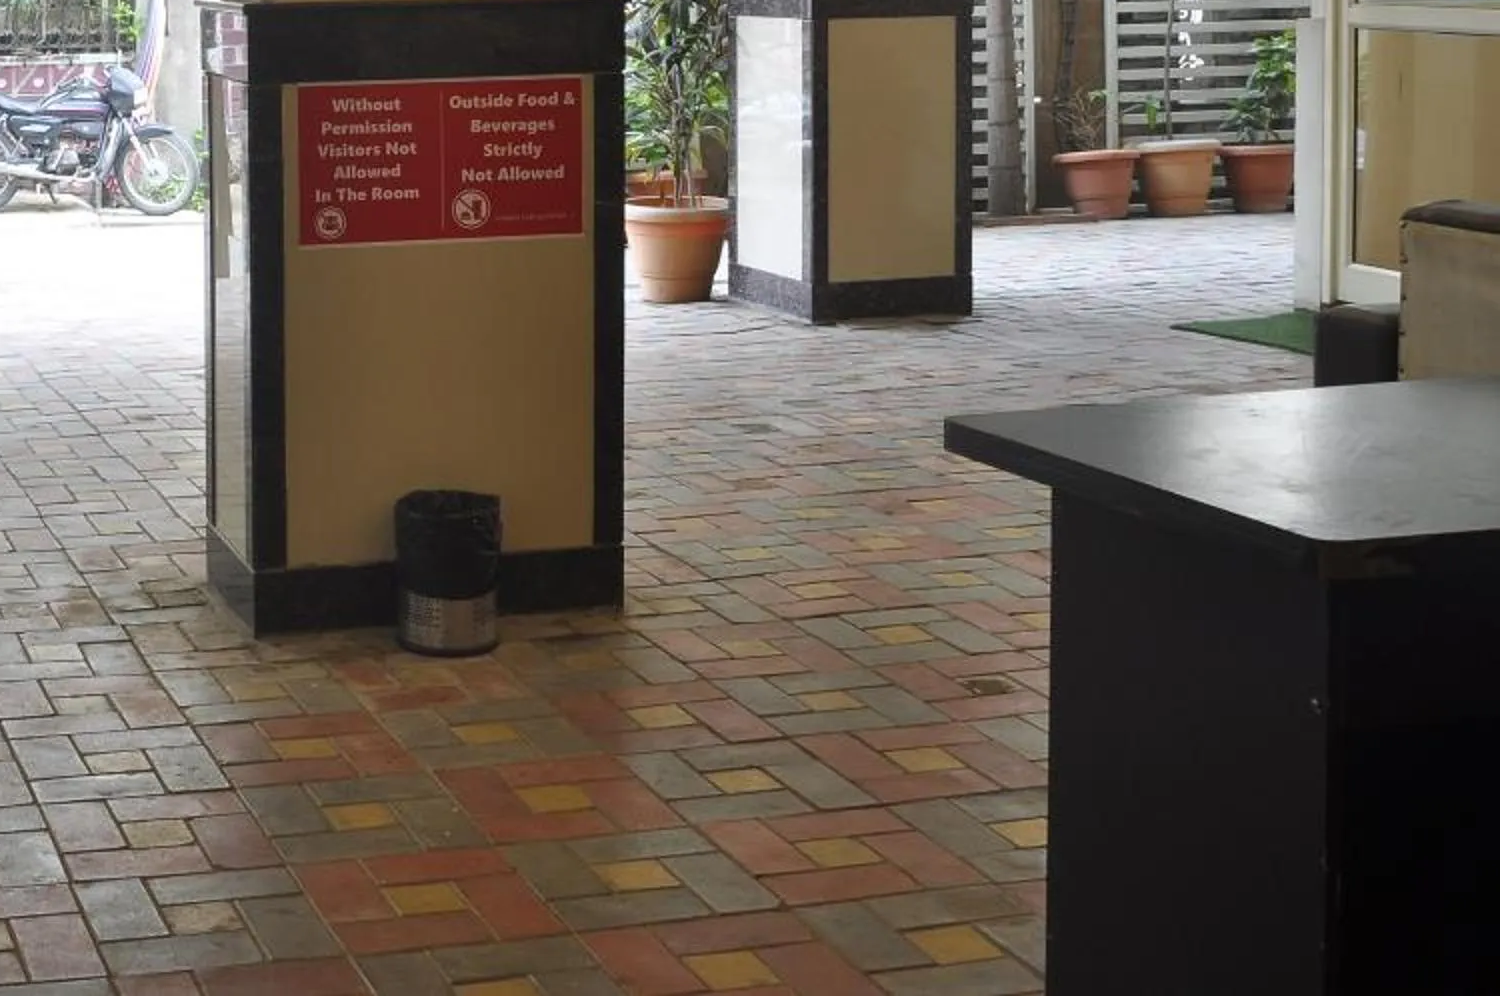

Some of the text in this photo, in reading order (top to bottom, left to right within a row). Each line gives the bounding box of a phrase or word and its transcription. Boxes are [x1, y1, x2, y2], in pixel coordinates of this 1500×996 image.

[331, 97, 402, 113] Without
[449, 92, 575, 110] Outside Food &
[321, 121, 413, 135] Permission
[470, 119, 556, 136] Beverages
[318, 141, 417, 158] Visitors Not
[483, 142, 543, 158] Strictly
[333, 164, 402, 180] Allowed
[461, 165, 565, 182] Not Allowed
[315, 187, 420, 204] In The Room
